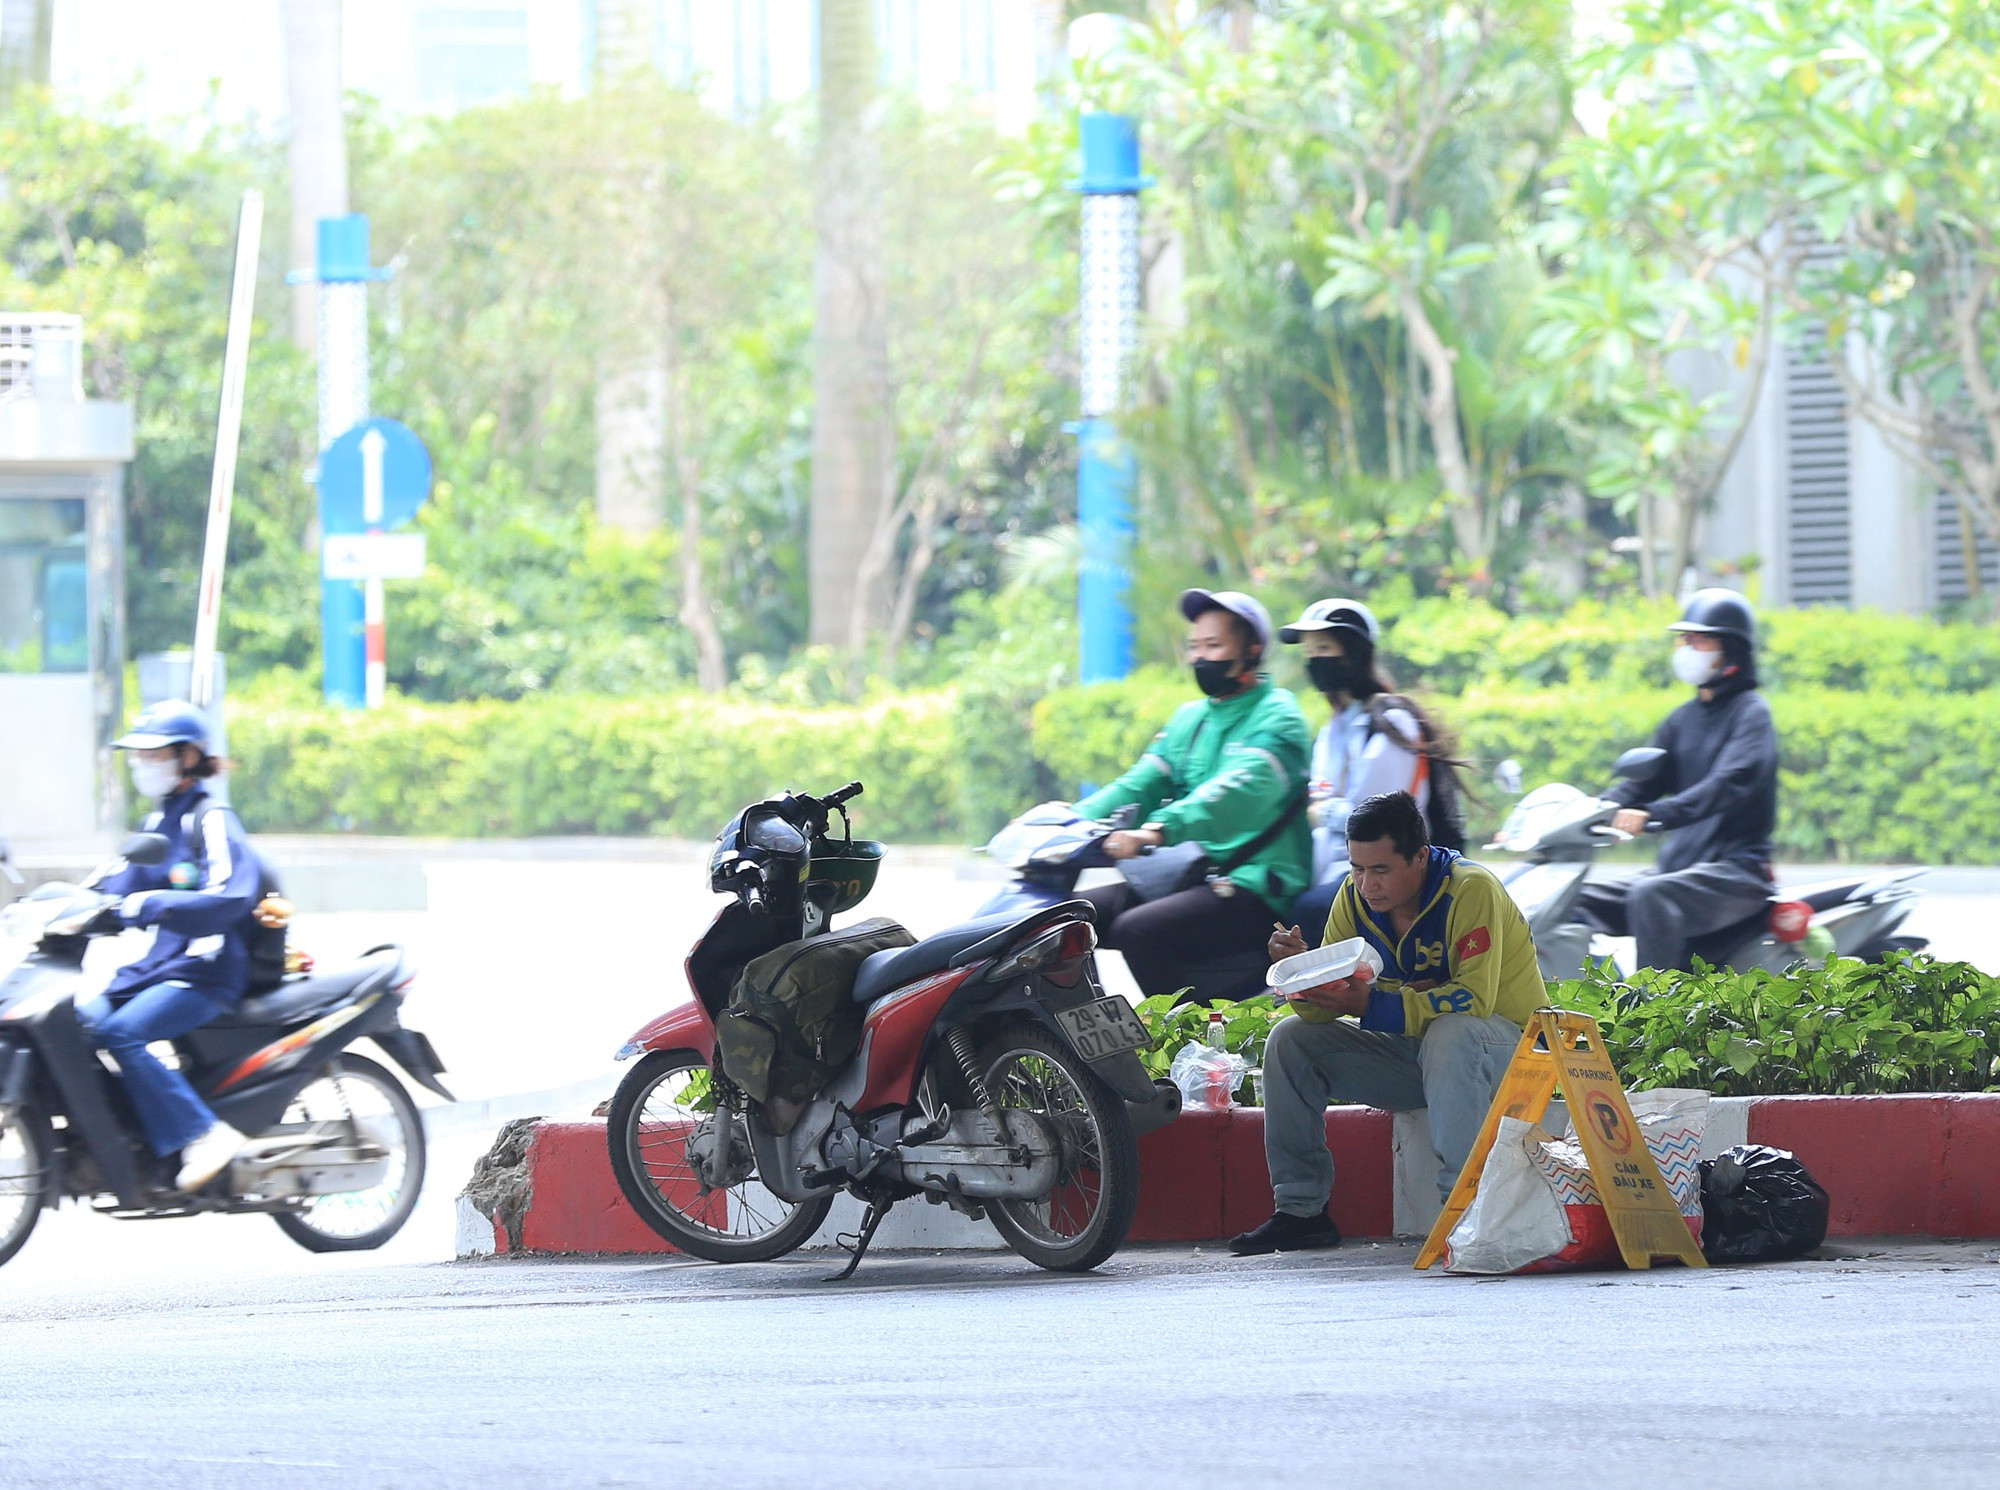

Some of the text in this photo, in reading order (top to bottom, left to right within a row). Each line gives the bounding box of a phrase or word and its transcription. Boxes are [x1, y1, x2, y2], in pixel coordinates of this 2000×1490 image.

[1414, 937, 1443, 971] be
[1428, 988, 1473, 1013] be
[1077, 1021, 1146, 1057] 070.43
[1567, 1067, 1613, 1081] NO PARKING
[1593, 1103, 1618, 1140] P
[1638, 1178, 1655, 1189] XE
